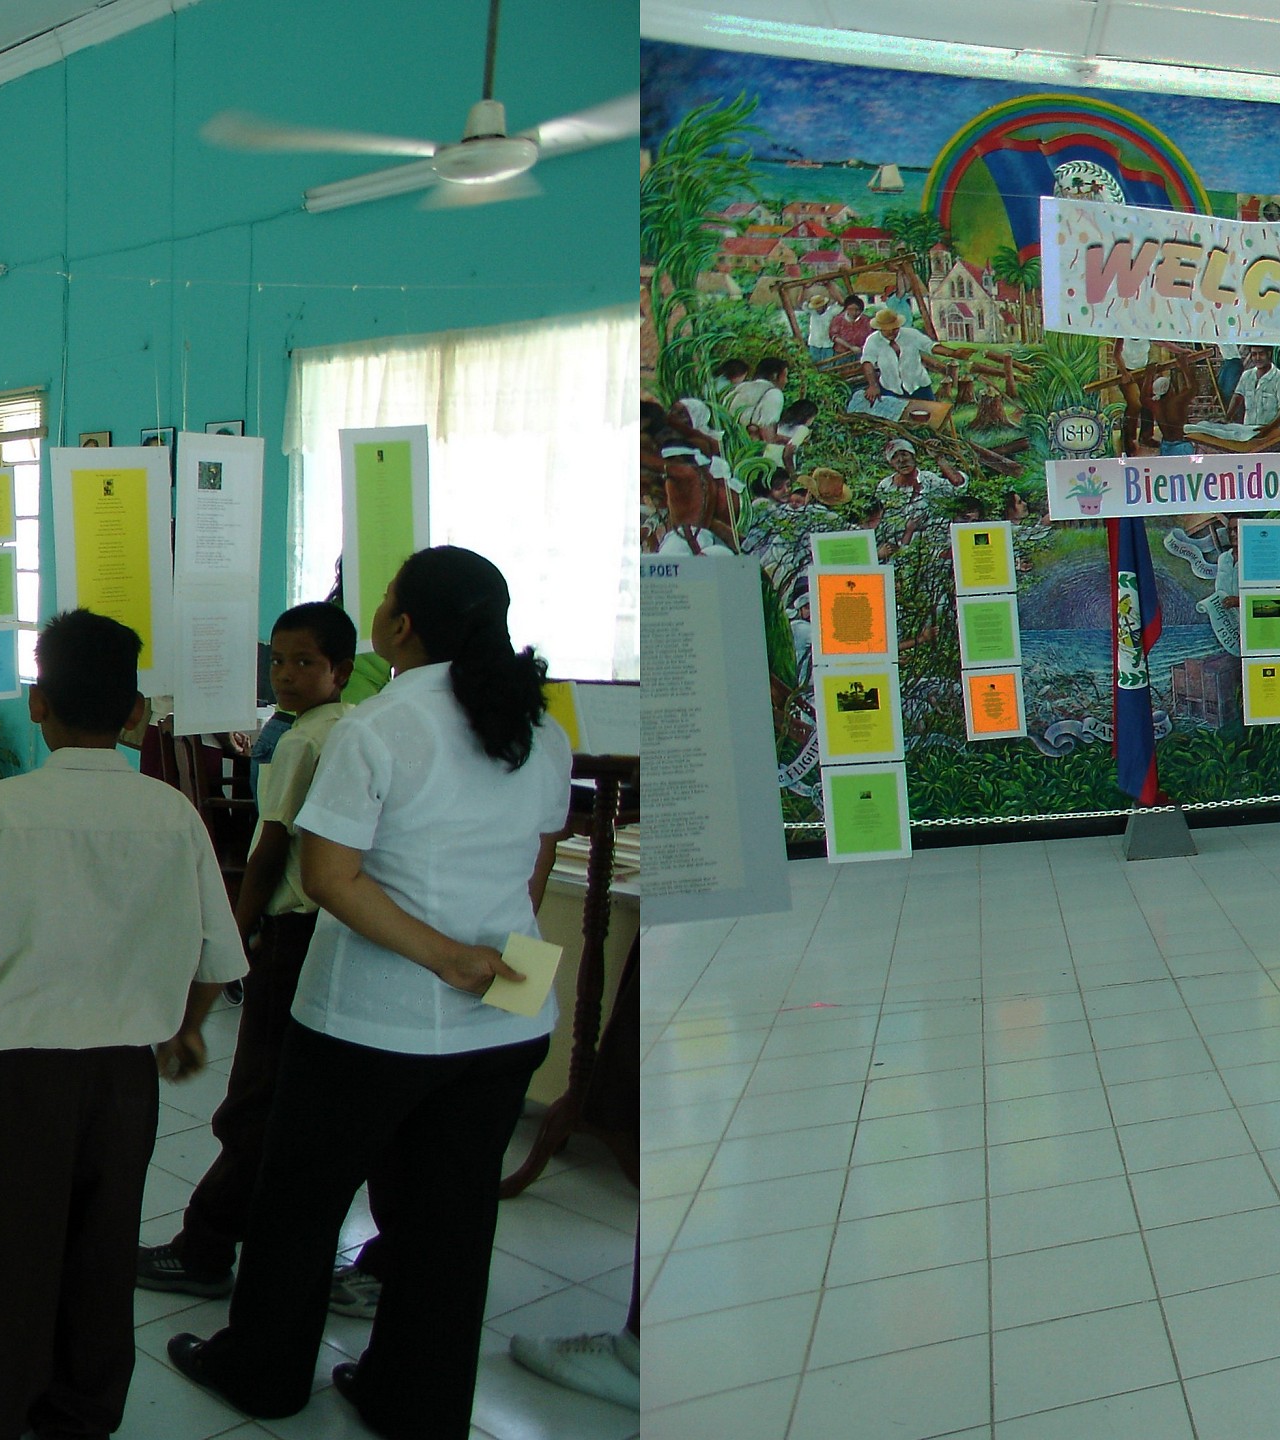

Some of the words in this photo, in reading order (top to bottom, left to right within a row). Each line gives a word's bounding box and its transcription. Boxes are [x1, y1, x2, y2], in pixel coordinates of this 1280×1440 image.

[1061, 425, 1095, 443] 1849
[650, 564, 679, 577] POET
[1217, 627, 1236, 648] 1981
